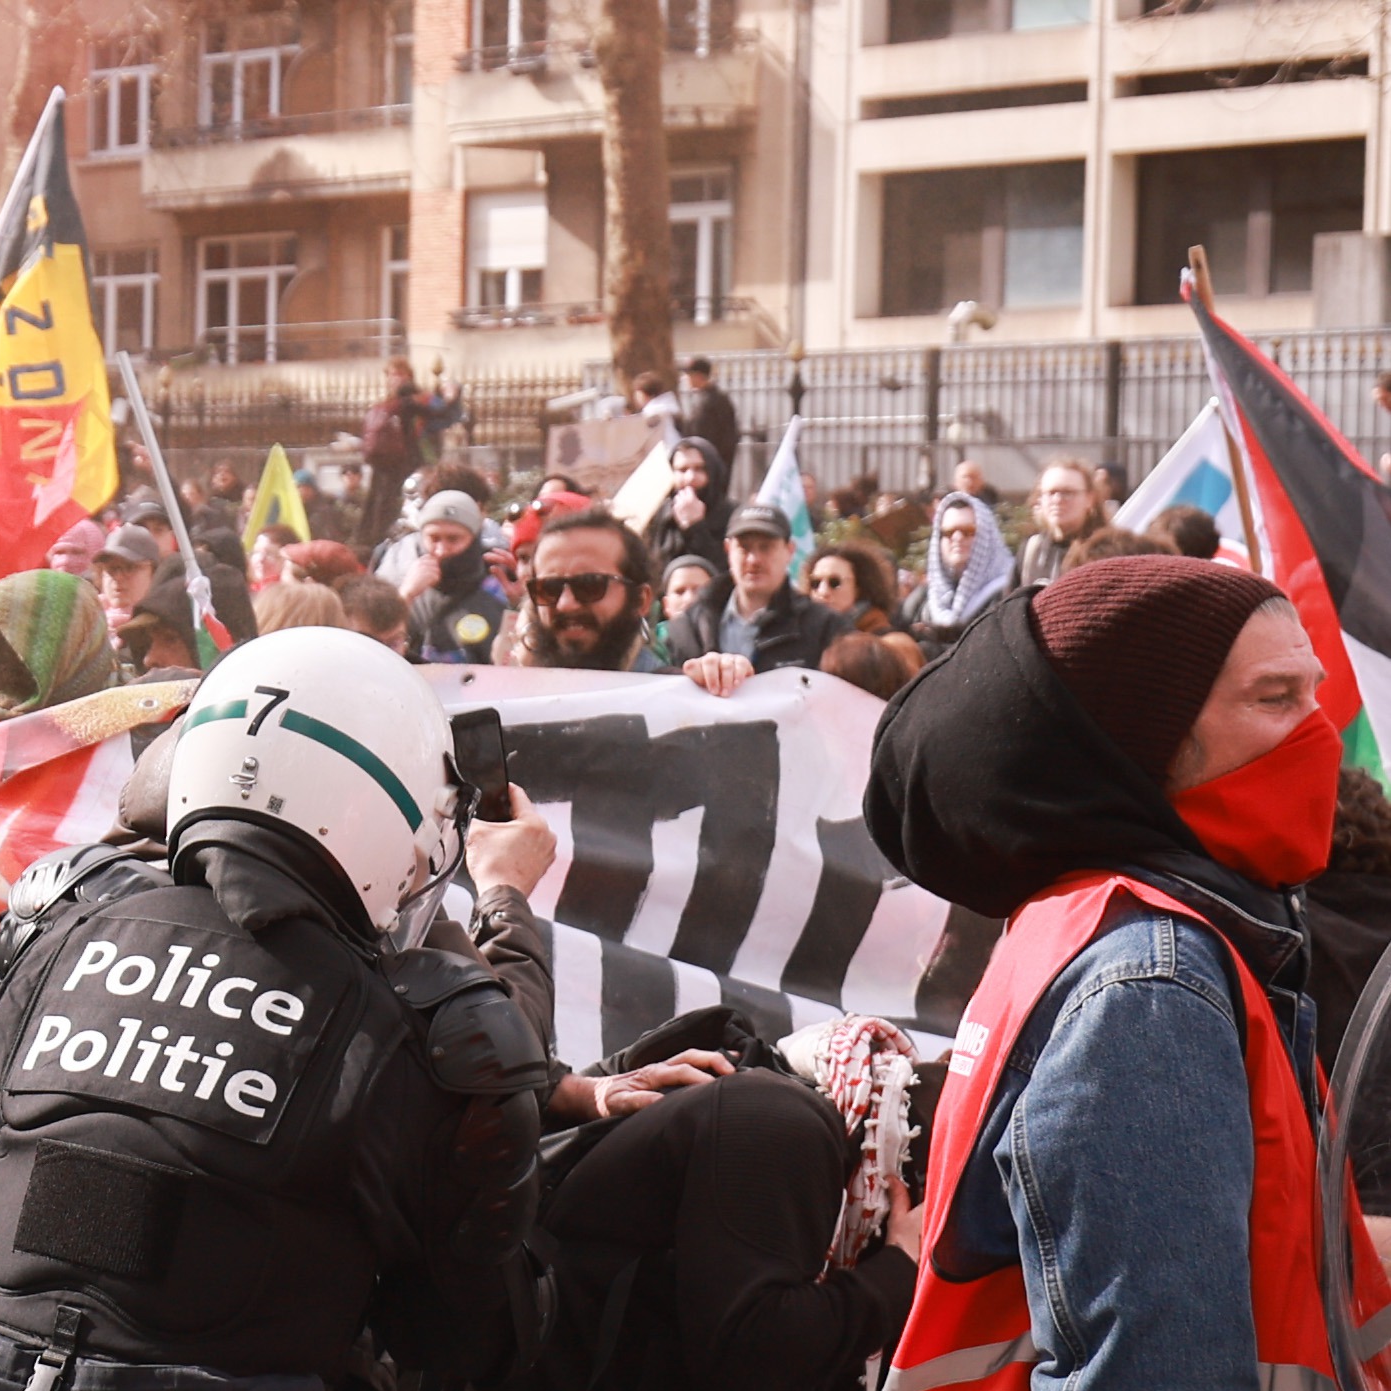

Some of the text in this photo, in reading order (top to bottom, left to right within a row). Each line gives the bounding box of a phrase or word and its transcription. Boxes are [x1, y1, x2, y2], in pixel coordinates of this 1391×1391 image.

[247, 685, 290, 736] 7
[62, 940, 305, 1037] Police
[22, 1015, 278, 1119] Politie
